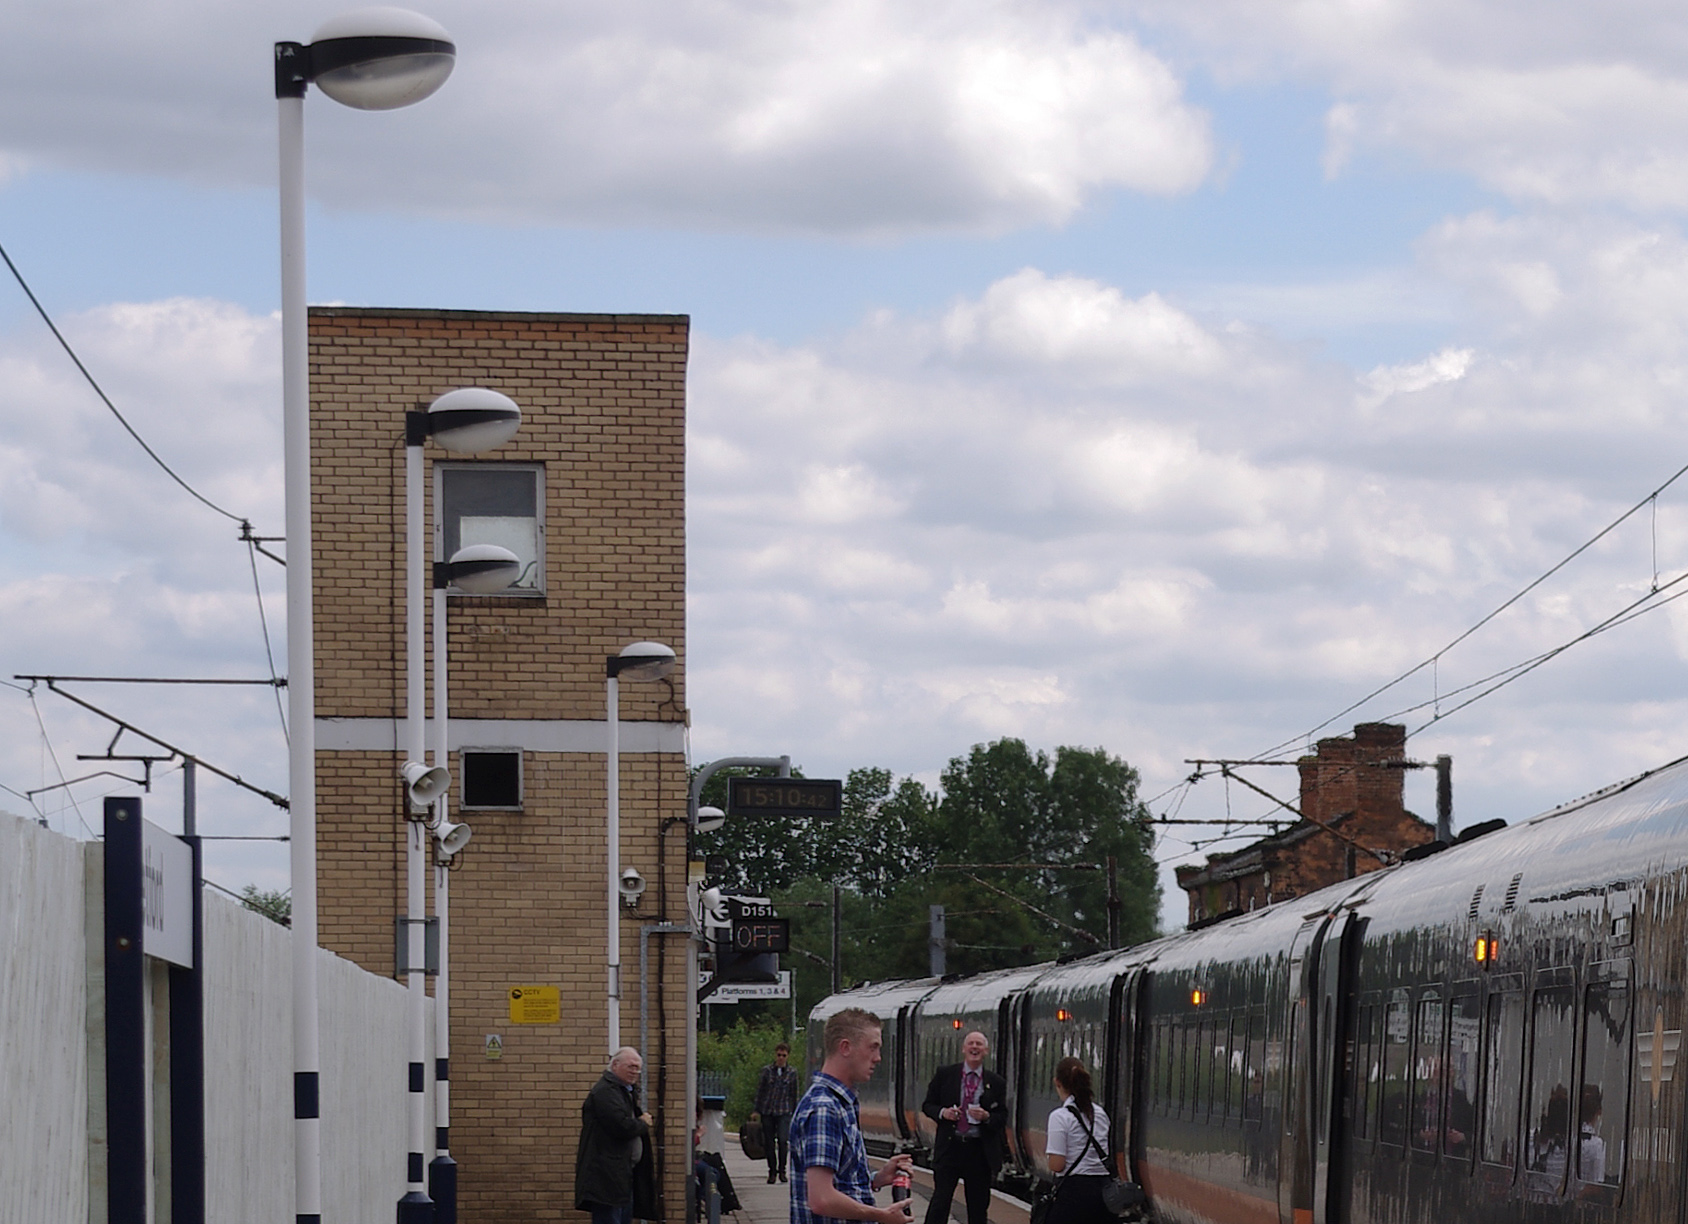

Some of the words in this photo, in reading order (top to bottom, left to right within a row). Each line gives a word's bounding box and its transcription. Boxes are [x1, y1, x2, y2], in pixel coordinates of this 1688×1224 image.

[742, 906, 771, 916] D151
[737, 925, 780, 948] OFF
[721, 987, 757, 995] Platforms
